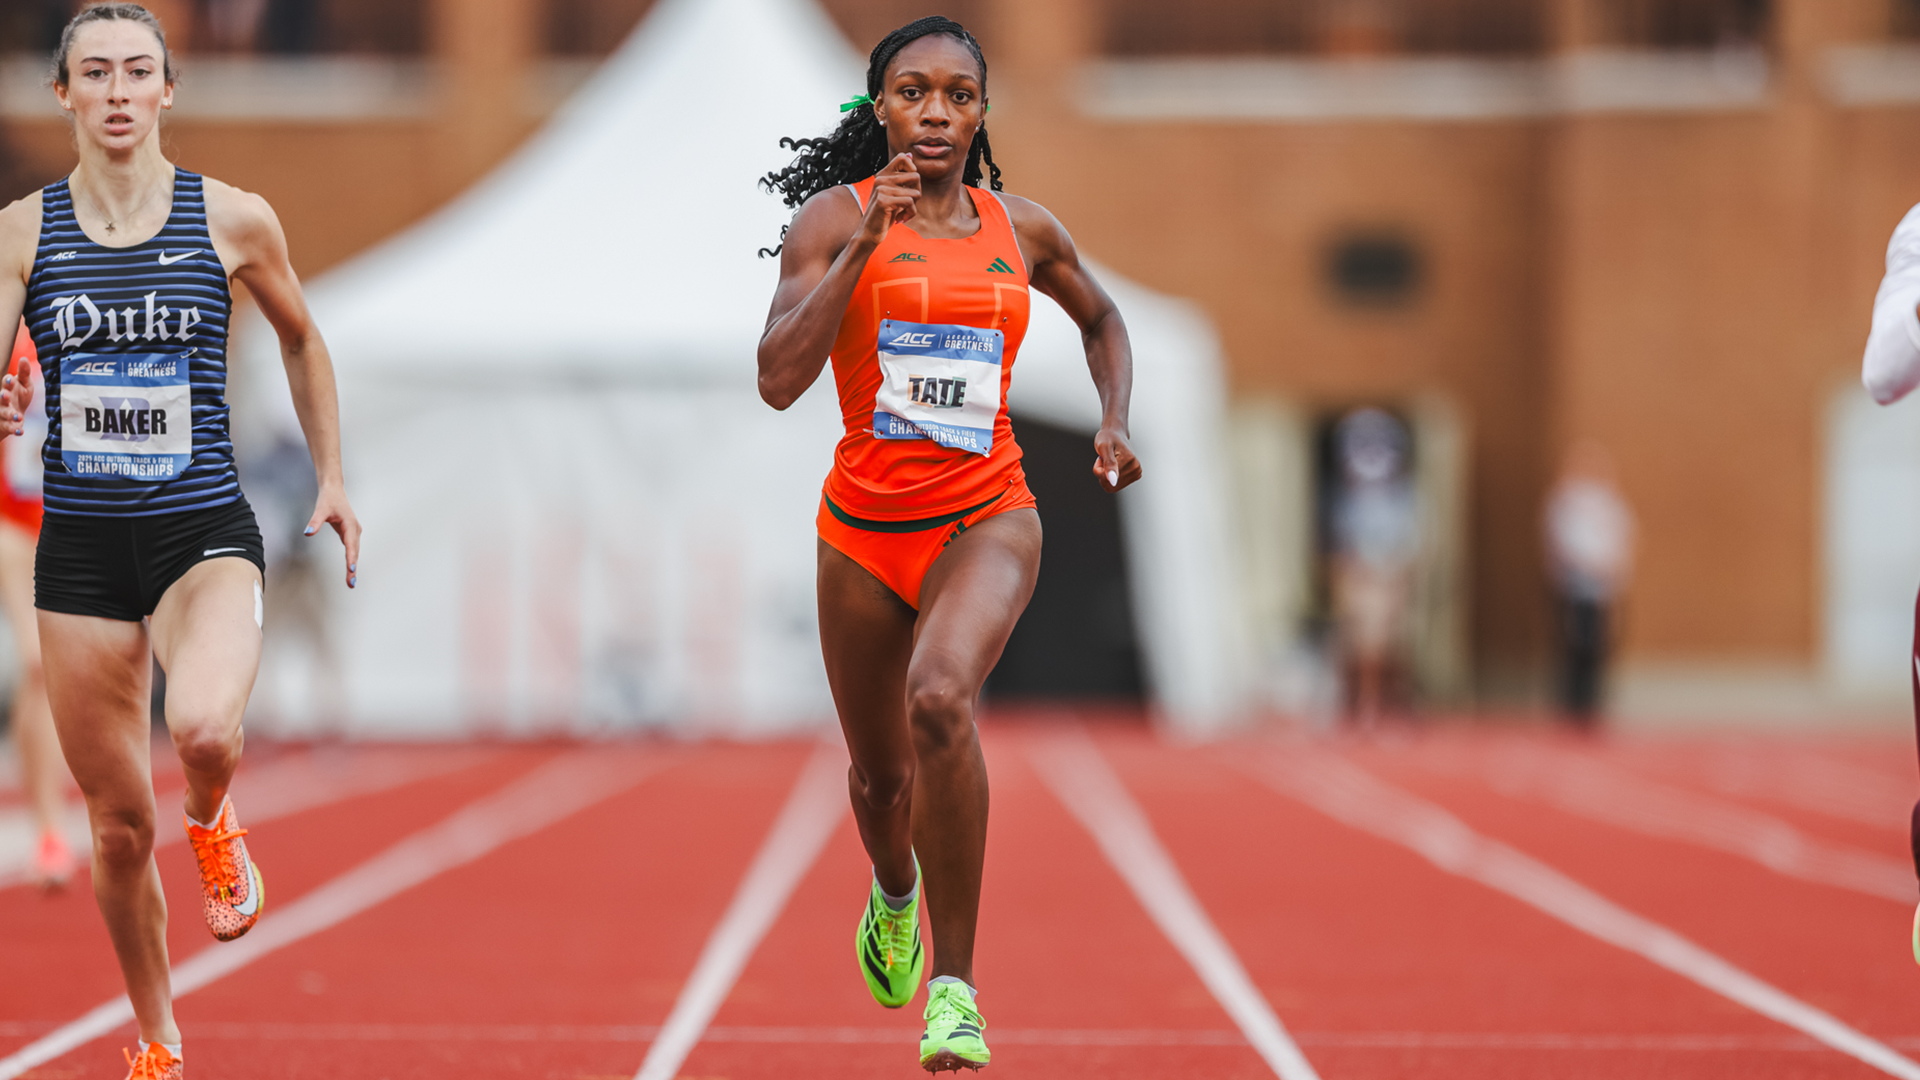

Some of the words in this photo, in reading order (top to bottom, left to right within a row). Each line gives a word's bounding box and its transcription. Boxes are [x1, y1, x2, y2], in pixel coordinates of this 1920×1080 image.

[53, 250, 77, 261] ACC
[889, 252, 927, 262] ACC
[49, 291, 202, 351] Duke
[889, 332, 936, 346] ACC
[944, 339, 994, 353] GREATNESS
[72, 362, 117, 374] ACC
[127, 366, 177, 378] GREATNESS
[908, 377, 967, 408] TATE
[84, 407, 167, 435] BAKER
[889, 422, 978, 448] CHAIONSHIPS
[106, 455, 132, 463] OUTDOOR
[133, 456, 151, 464] TRACK
[77, 461, 174, 476] CHAMPIONSHIPS
